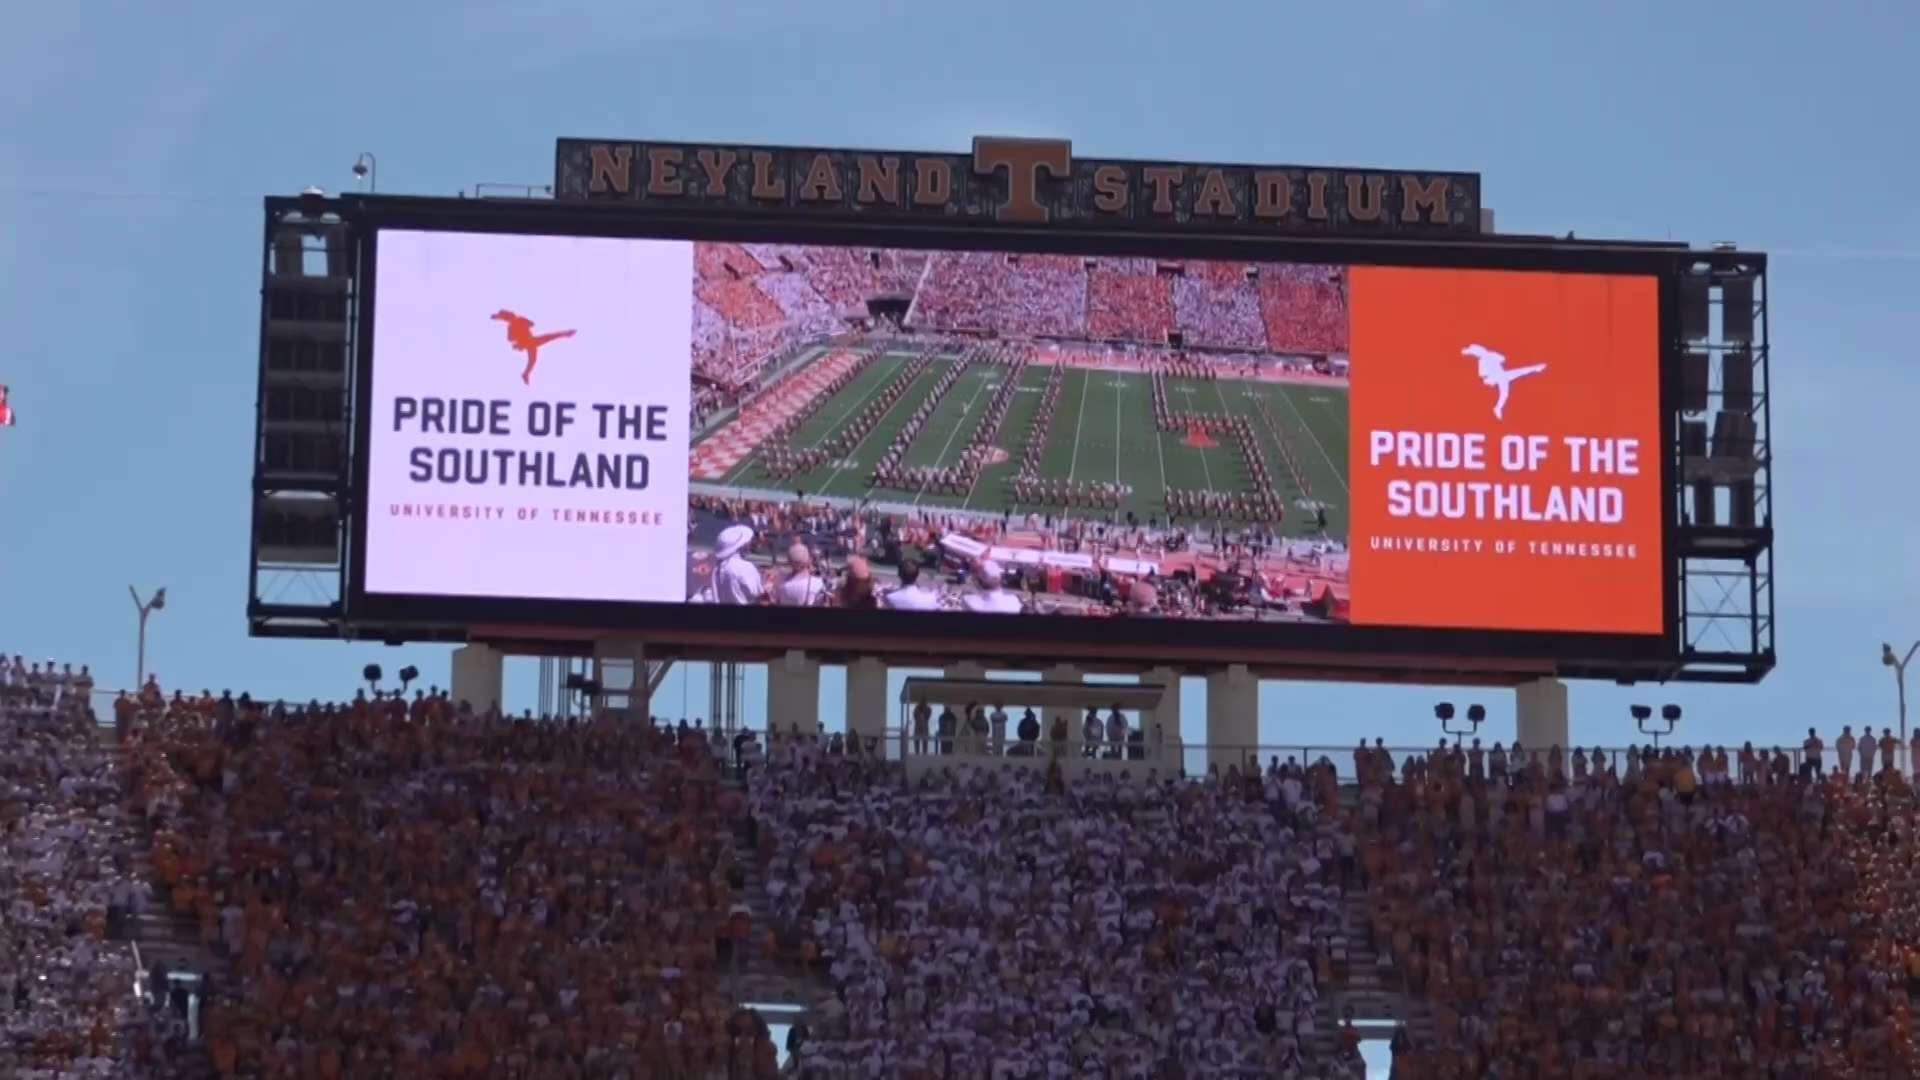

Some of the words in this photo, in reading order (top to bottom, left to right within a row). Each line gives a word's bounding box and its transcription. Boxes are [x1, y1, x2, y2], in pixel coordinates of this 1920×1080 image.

[589, 144, 952, 205] NEYLAND
[973, 137, 1071, 222] T
[1092, 164, 1451, 225] STADIUM
[393, 396, 512, 435] PRIDE
[527, 401, 576, 438] OF
[592, 403, 669, 441] THE
[409, 446, 650, 490] SOUTHLAND
[1370, 430, 1486, 470] PRIDE
[1501, 435, 1549, 471] OF
[1563, 436, 1639, 475] THE
[389, 503, 505, 520] UNIVERSITY
[517, 507, 539, 521] OF
[553, 508, 663, 526] TENNESSEE
[1387, 480, 1624, 524] SOUTHLAND
[1370, 536, 1483, 552] UNIVERSITY
[1495, 540, 1517, 555] OF
[1529, 541, 1638, 559] TENNESSEE
